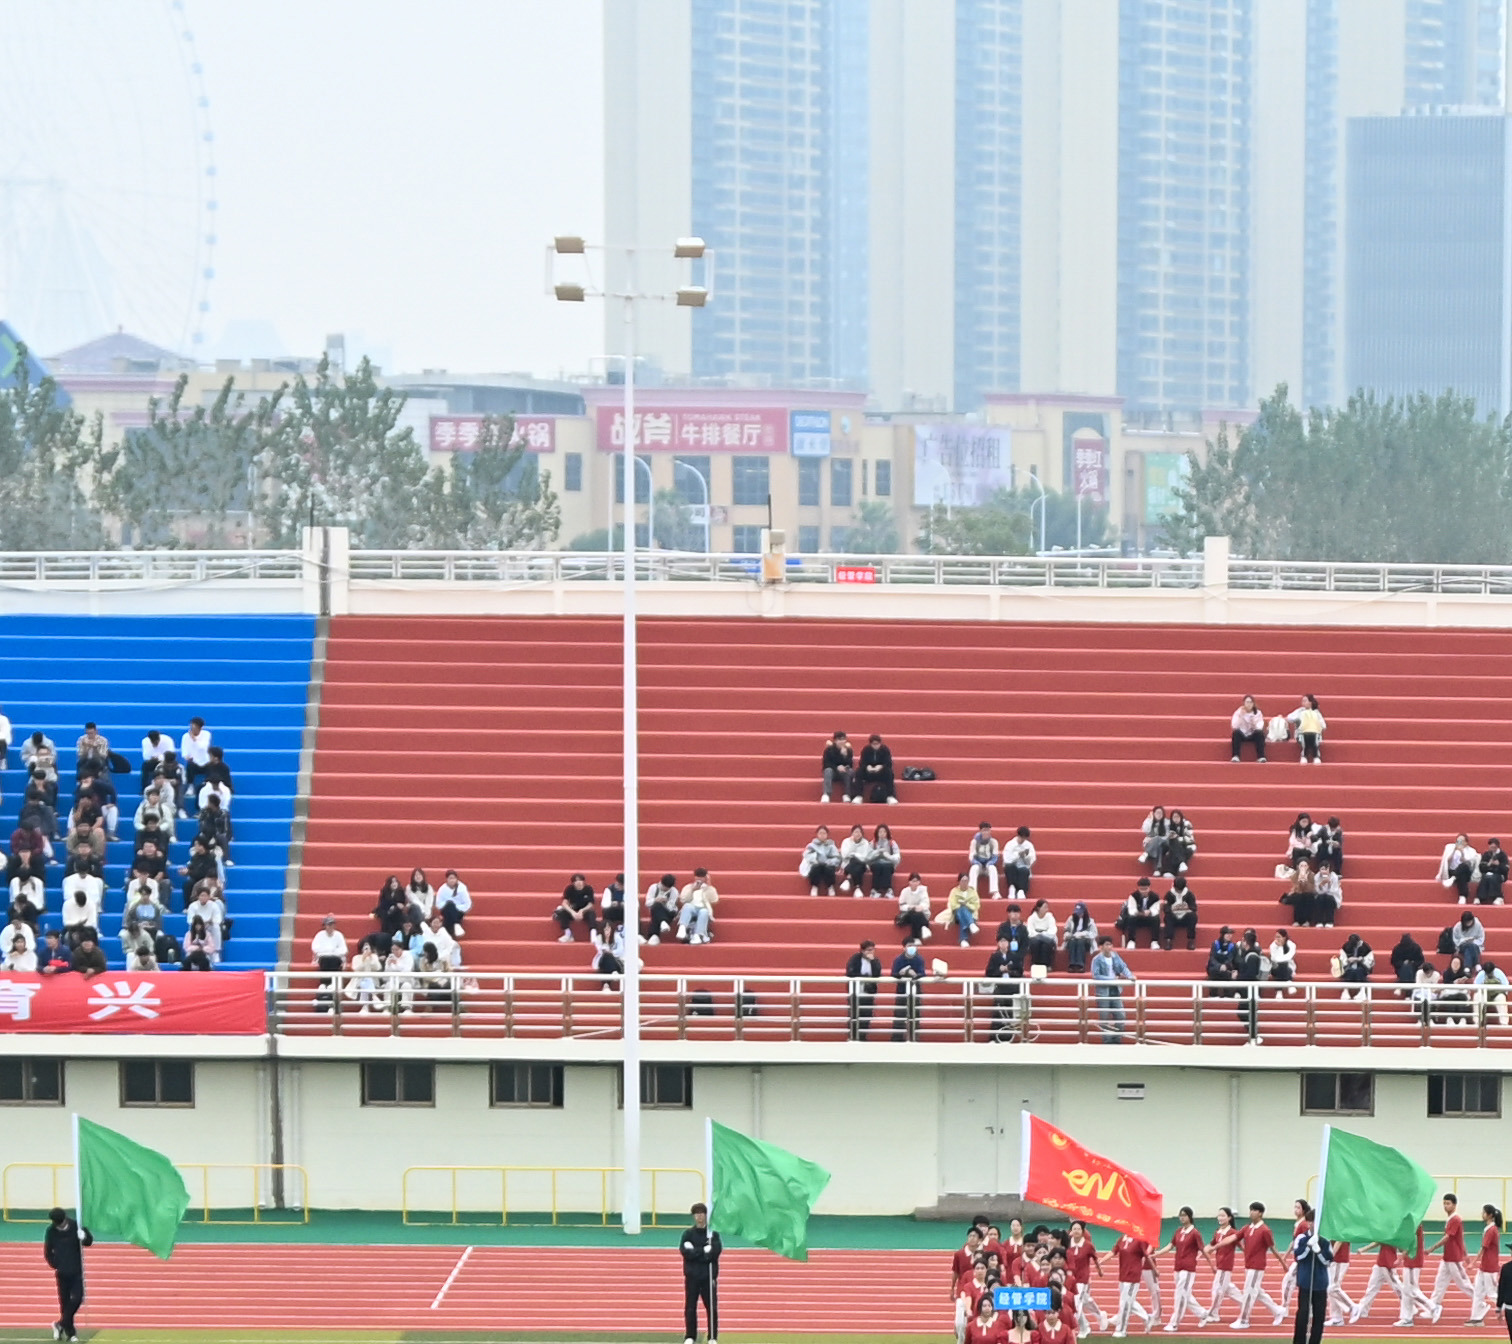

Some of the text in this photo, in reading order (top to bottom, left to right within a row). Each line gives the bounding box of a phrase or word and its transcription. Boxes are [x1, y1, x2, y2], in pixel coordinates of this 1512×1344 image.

[435, 421, 551, 448] 季季火锅
[681, 423, 762, 447] 牛排餐厅
